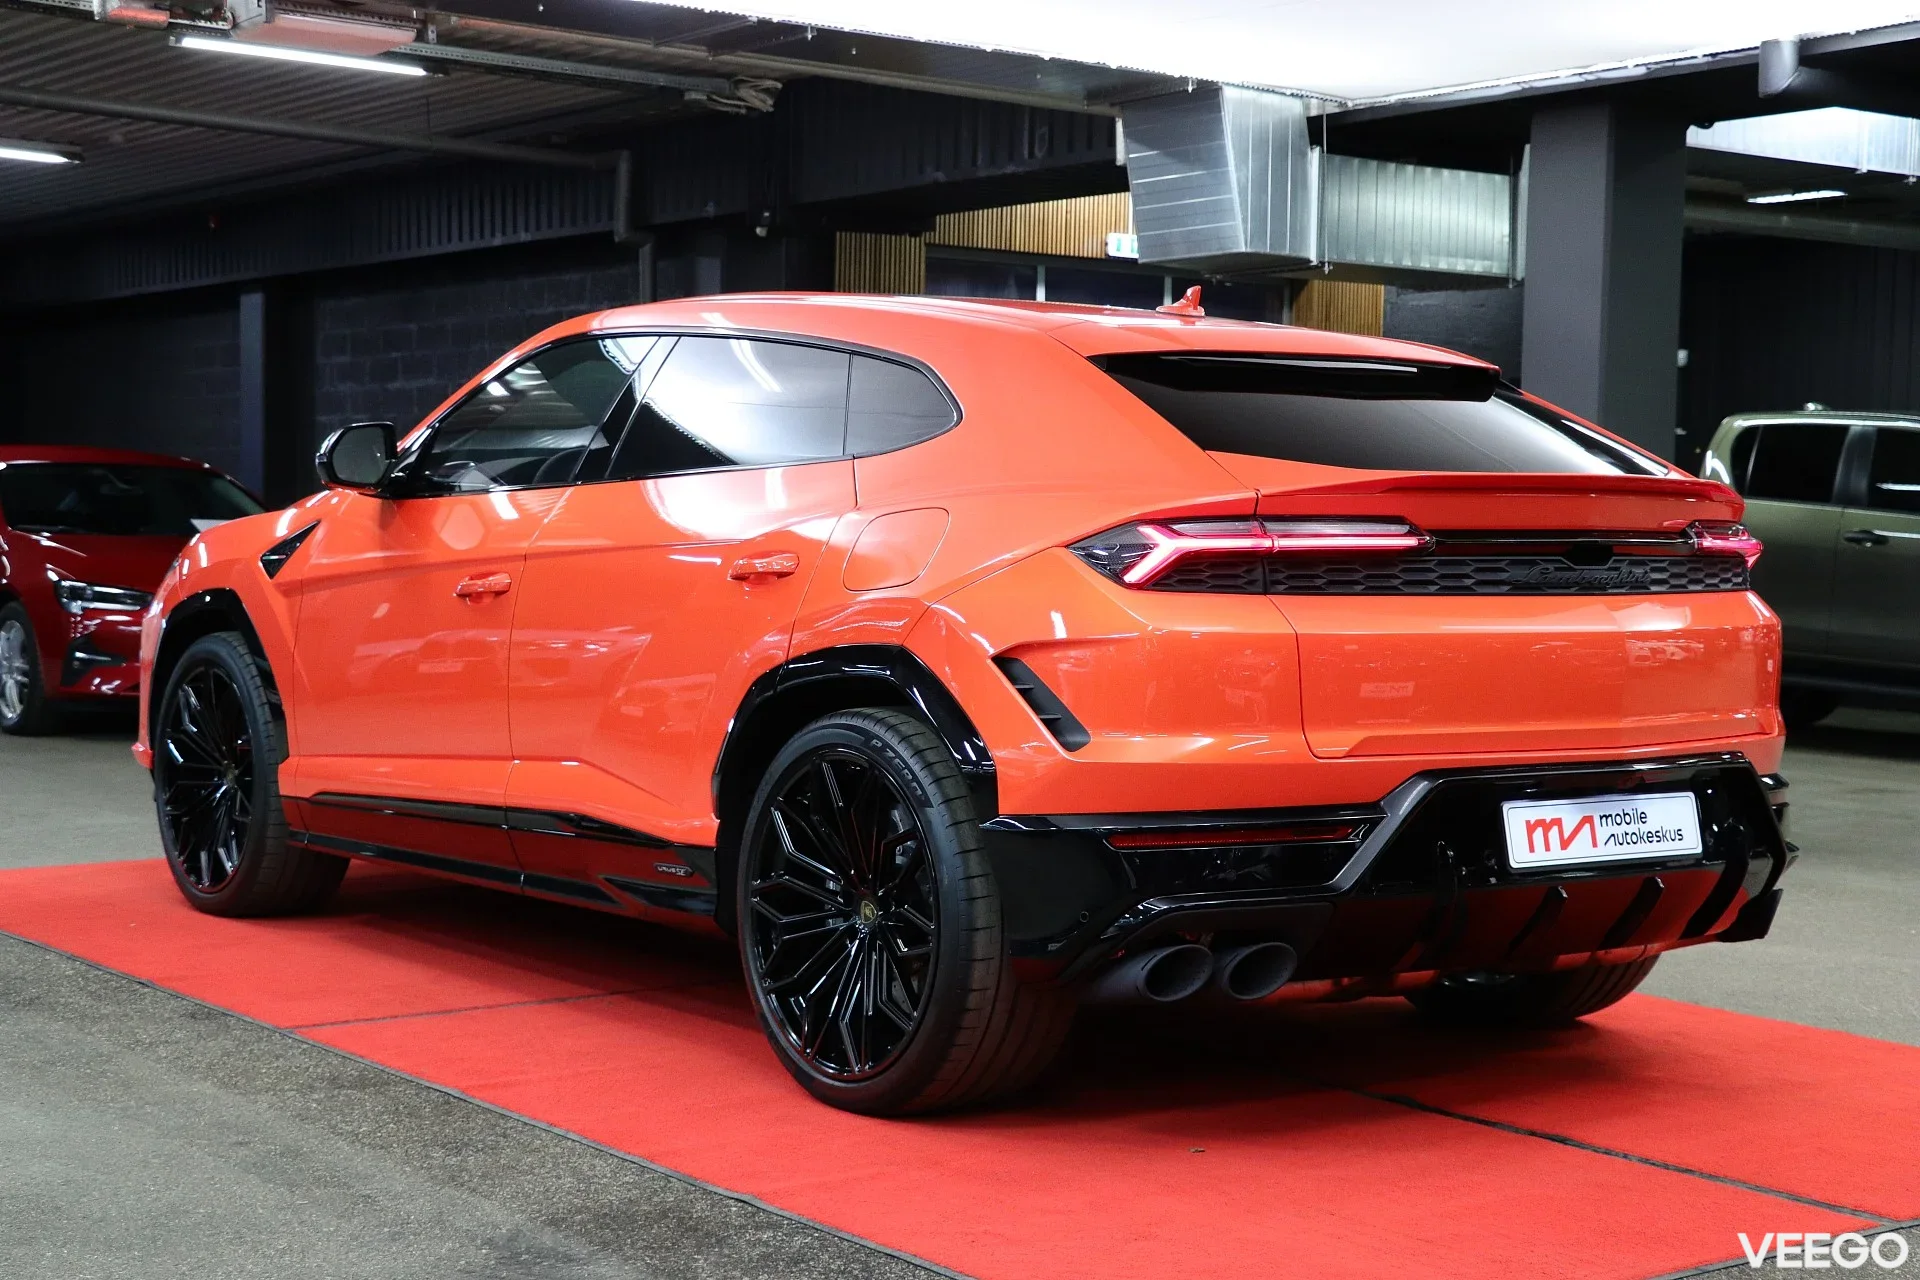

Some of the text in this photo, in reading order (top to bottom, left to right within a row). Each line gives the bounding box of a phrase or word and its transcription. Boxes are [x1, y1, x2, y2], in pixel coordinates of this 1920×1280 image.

[1512, 565, 1650, 588] Lamborghini
[1599, 807, 1648, 827] mobile
[1604, 825, 1684, 847] Autokeskus
